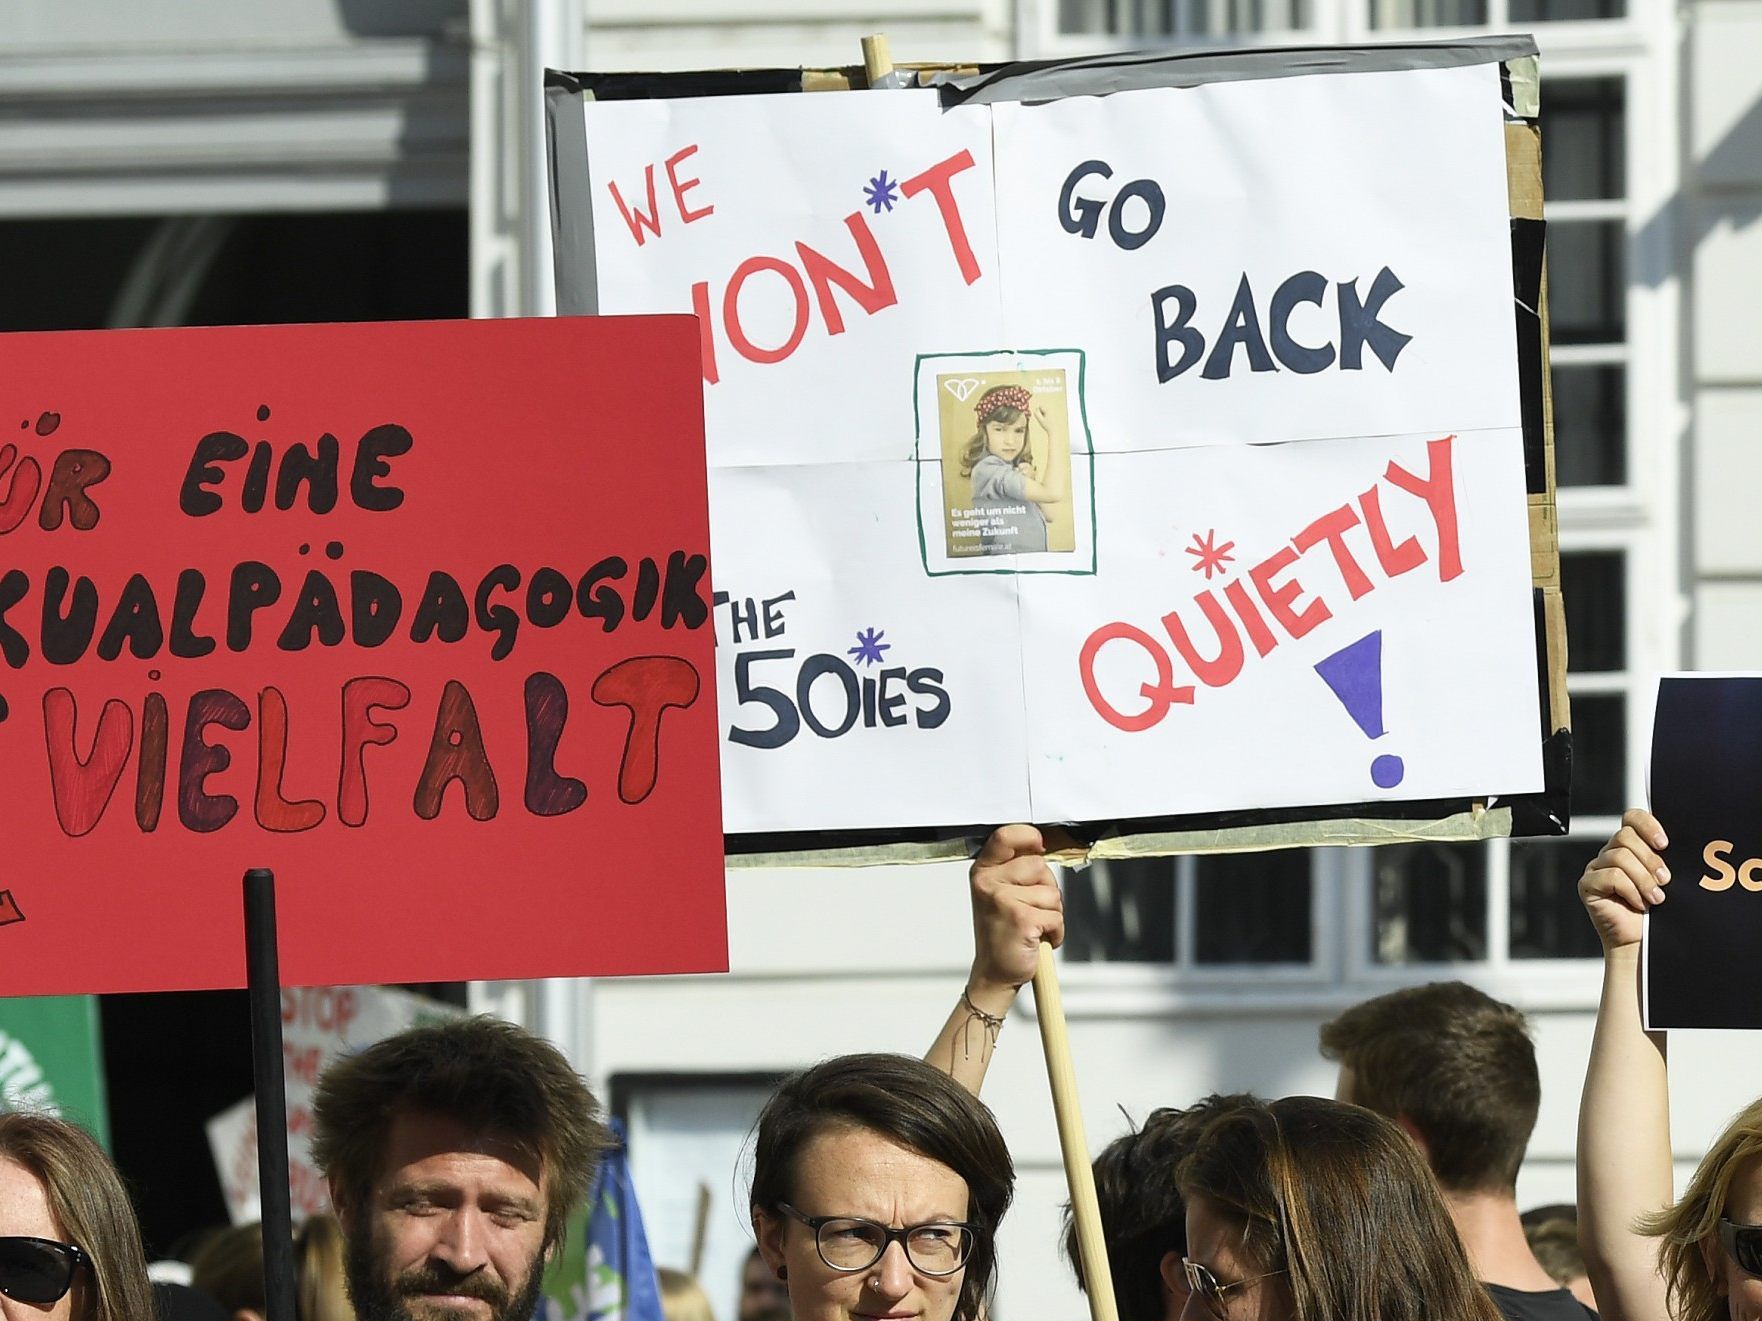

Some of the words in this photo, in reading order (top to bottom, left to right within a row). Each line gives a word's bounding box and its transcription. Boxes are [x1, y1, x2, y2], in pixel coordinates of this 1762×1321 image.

[608, 144, 714, 246] WE
[1058, 160, 1166, 250] GO
[1151, 266, 1413, 384] BACK
[982, 526, 1019, 537] Zukunft
[1079, 434, 1464, 733] QUIETLY
